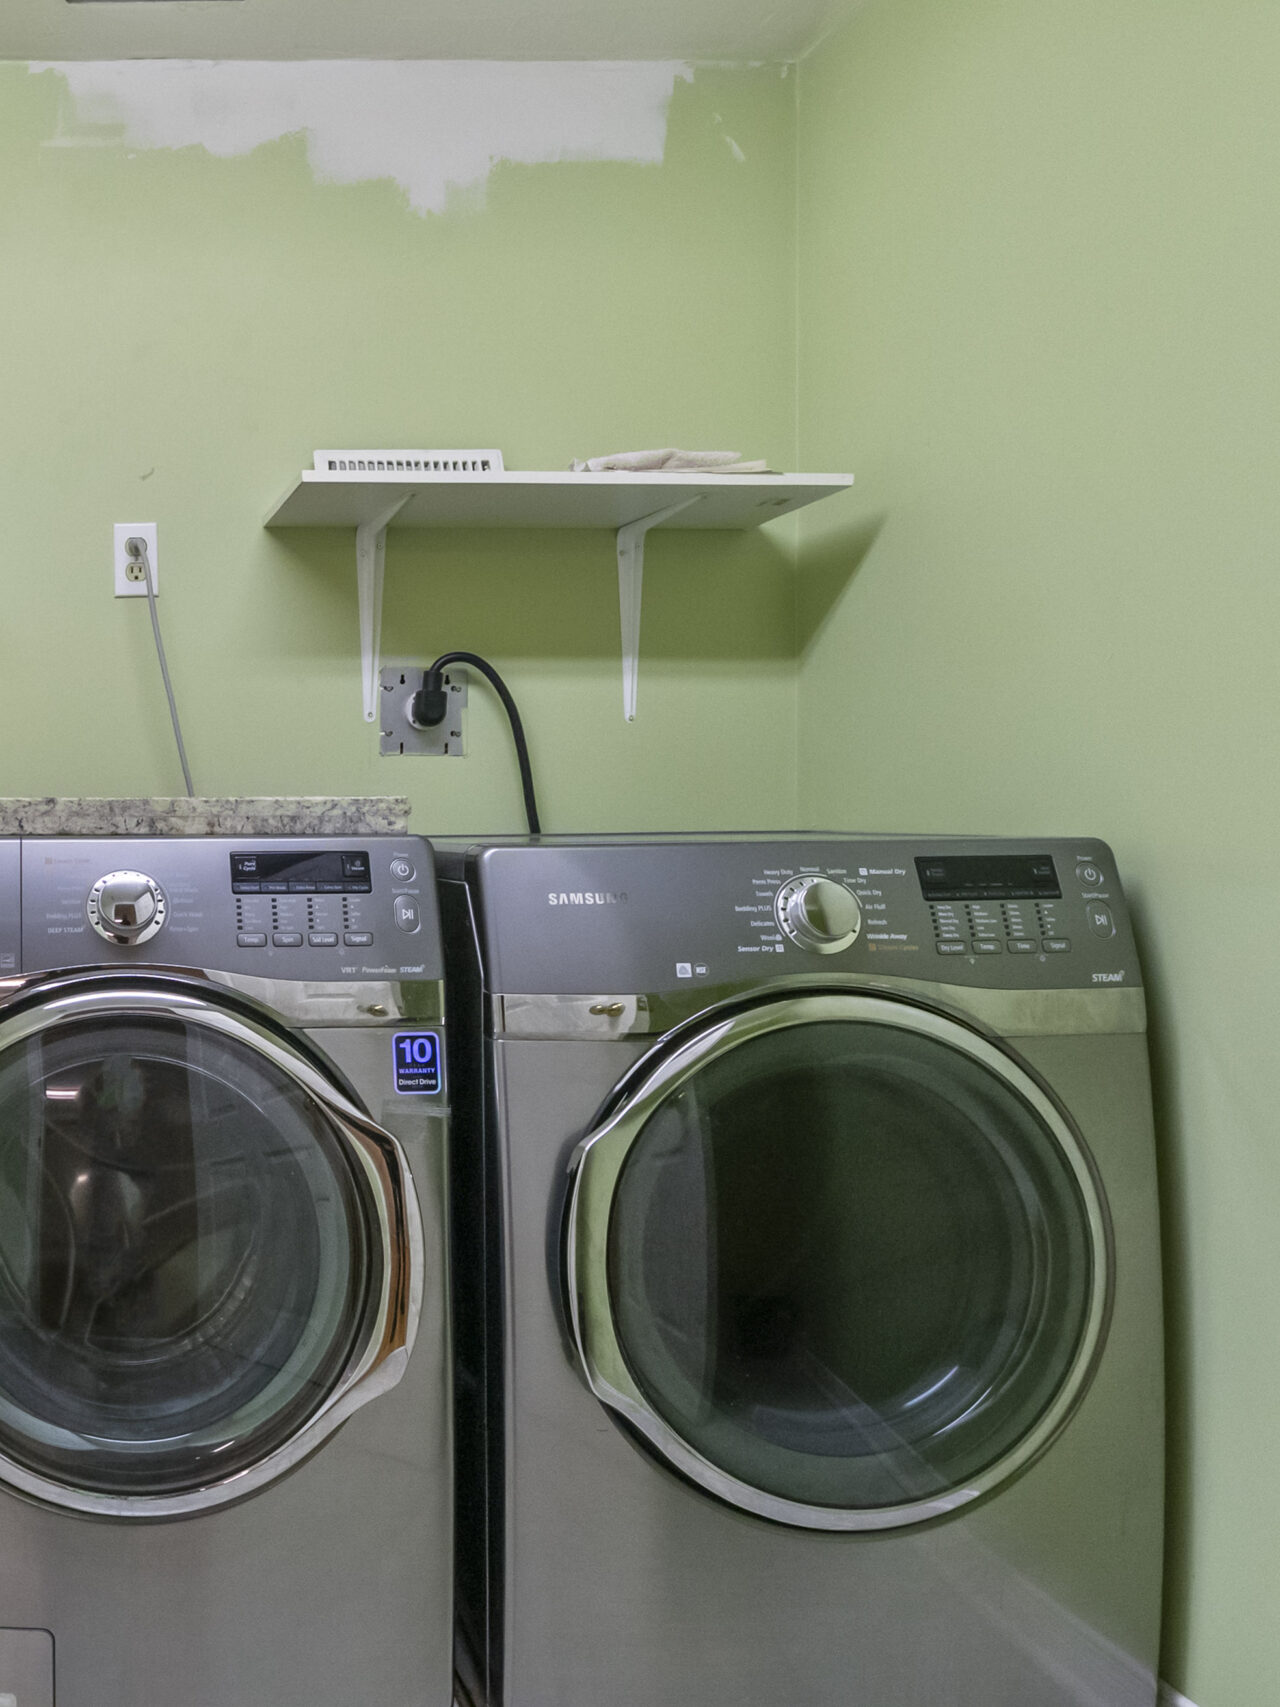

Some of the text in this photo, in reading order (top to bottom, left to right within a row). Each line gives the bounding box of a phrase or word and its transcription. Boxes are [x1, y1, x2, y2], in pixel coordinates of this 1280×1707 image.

[548, 893, 629, 905] SAMSUNG
[762, 945, 774, 953] Dry
[399, 1038, 433, 1063] 10
